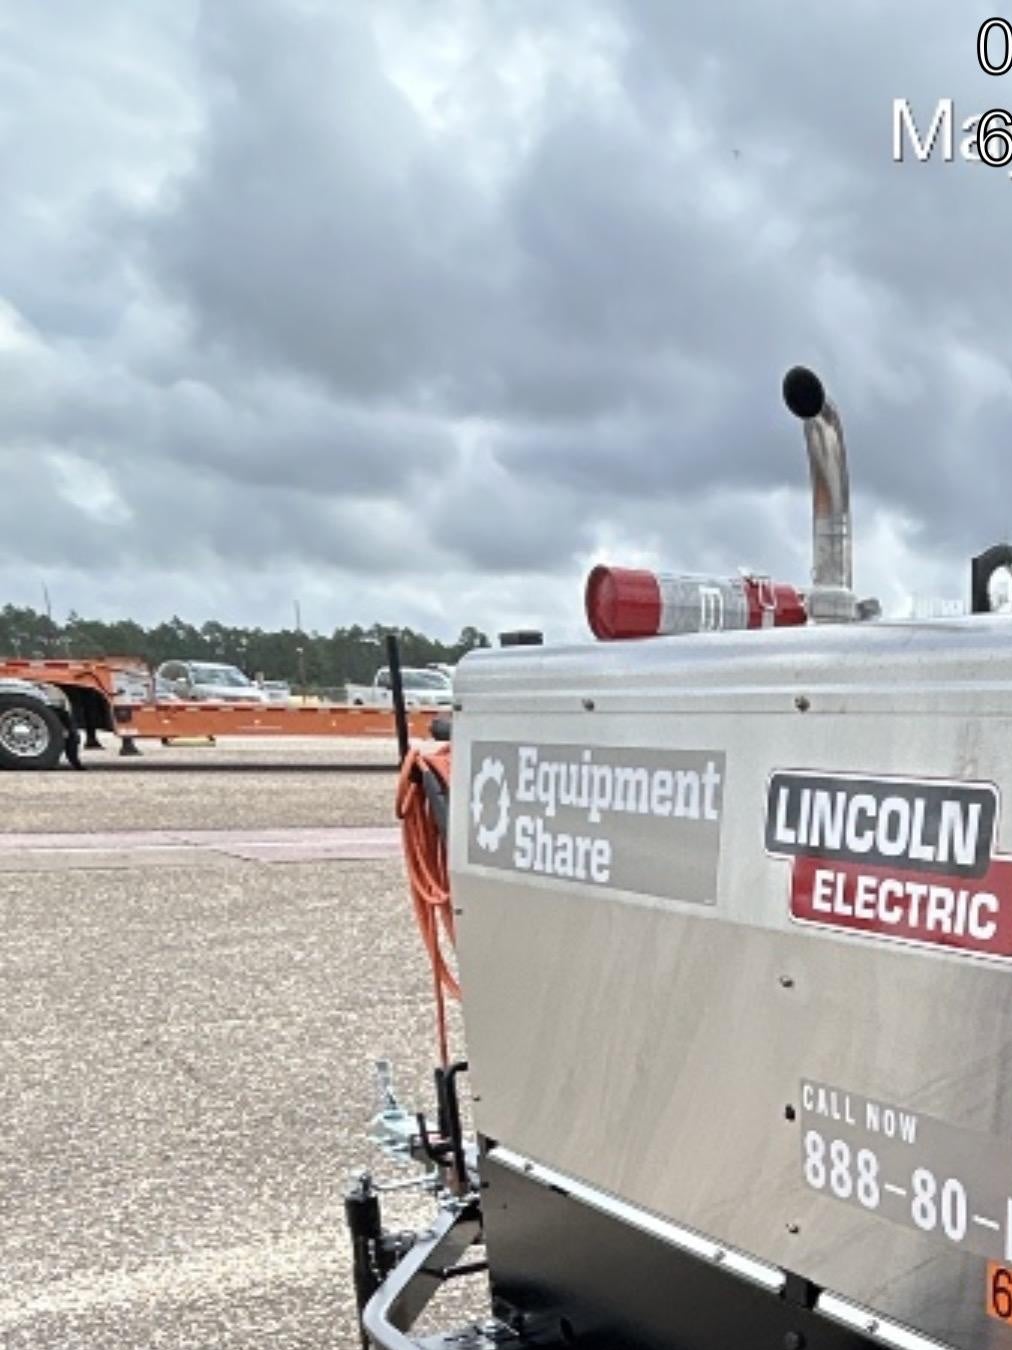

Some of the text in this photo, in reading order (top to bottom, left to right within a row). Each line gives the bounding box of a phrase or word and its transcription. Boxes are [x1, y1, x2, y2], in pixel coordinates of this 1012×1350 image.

[515, 746, 720, 823] Equipment
[513, 815, 612, 884] Share
[775, 787, 983, 866] LINCOLN
[812, 870, 998, 940] ELECTRIC
[803, 1084, 918, 1144] CALL NOW
